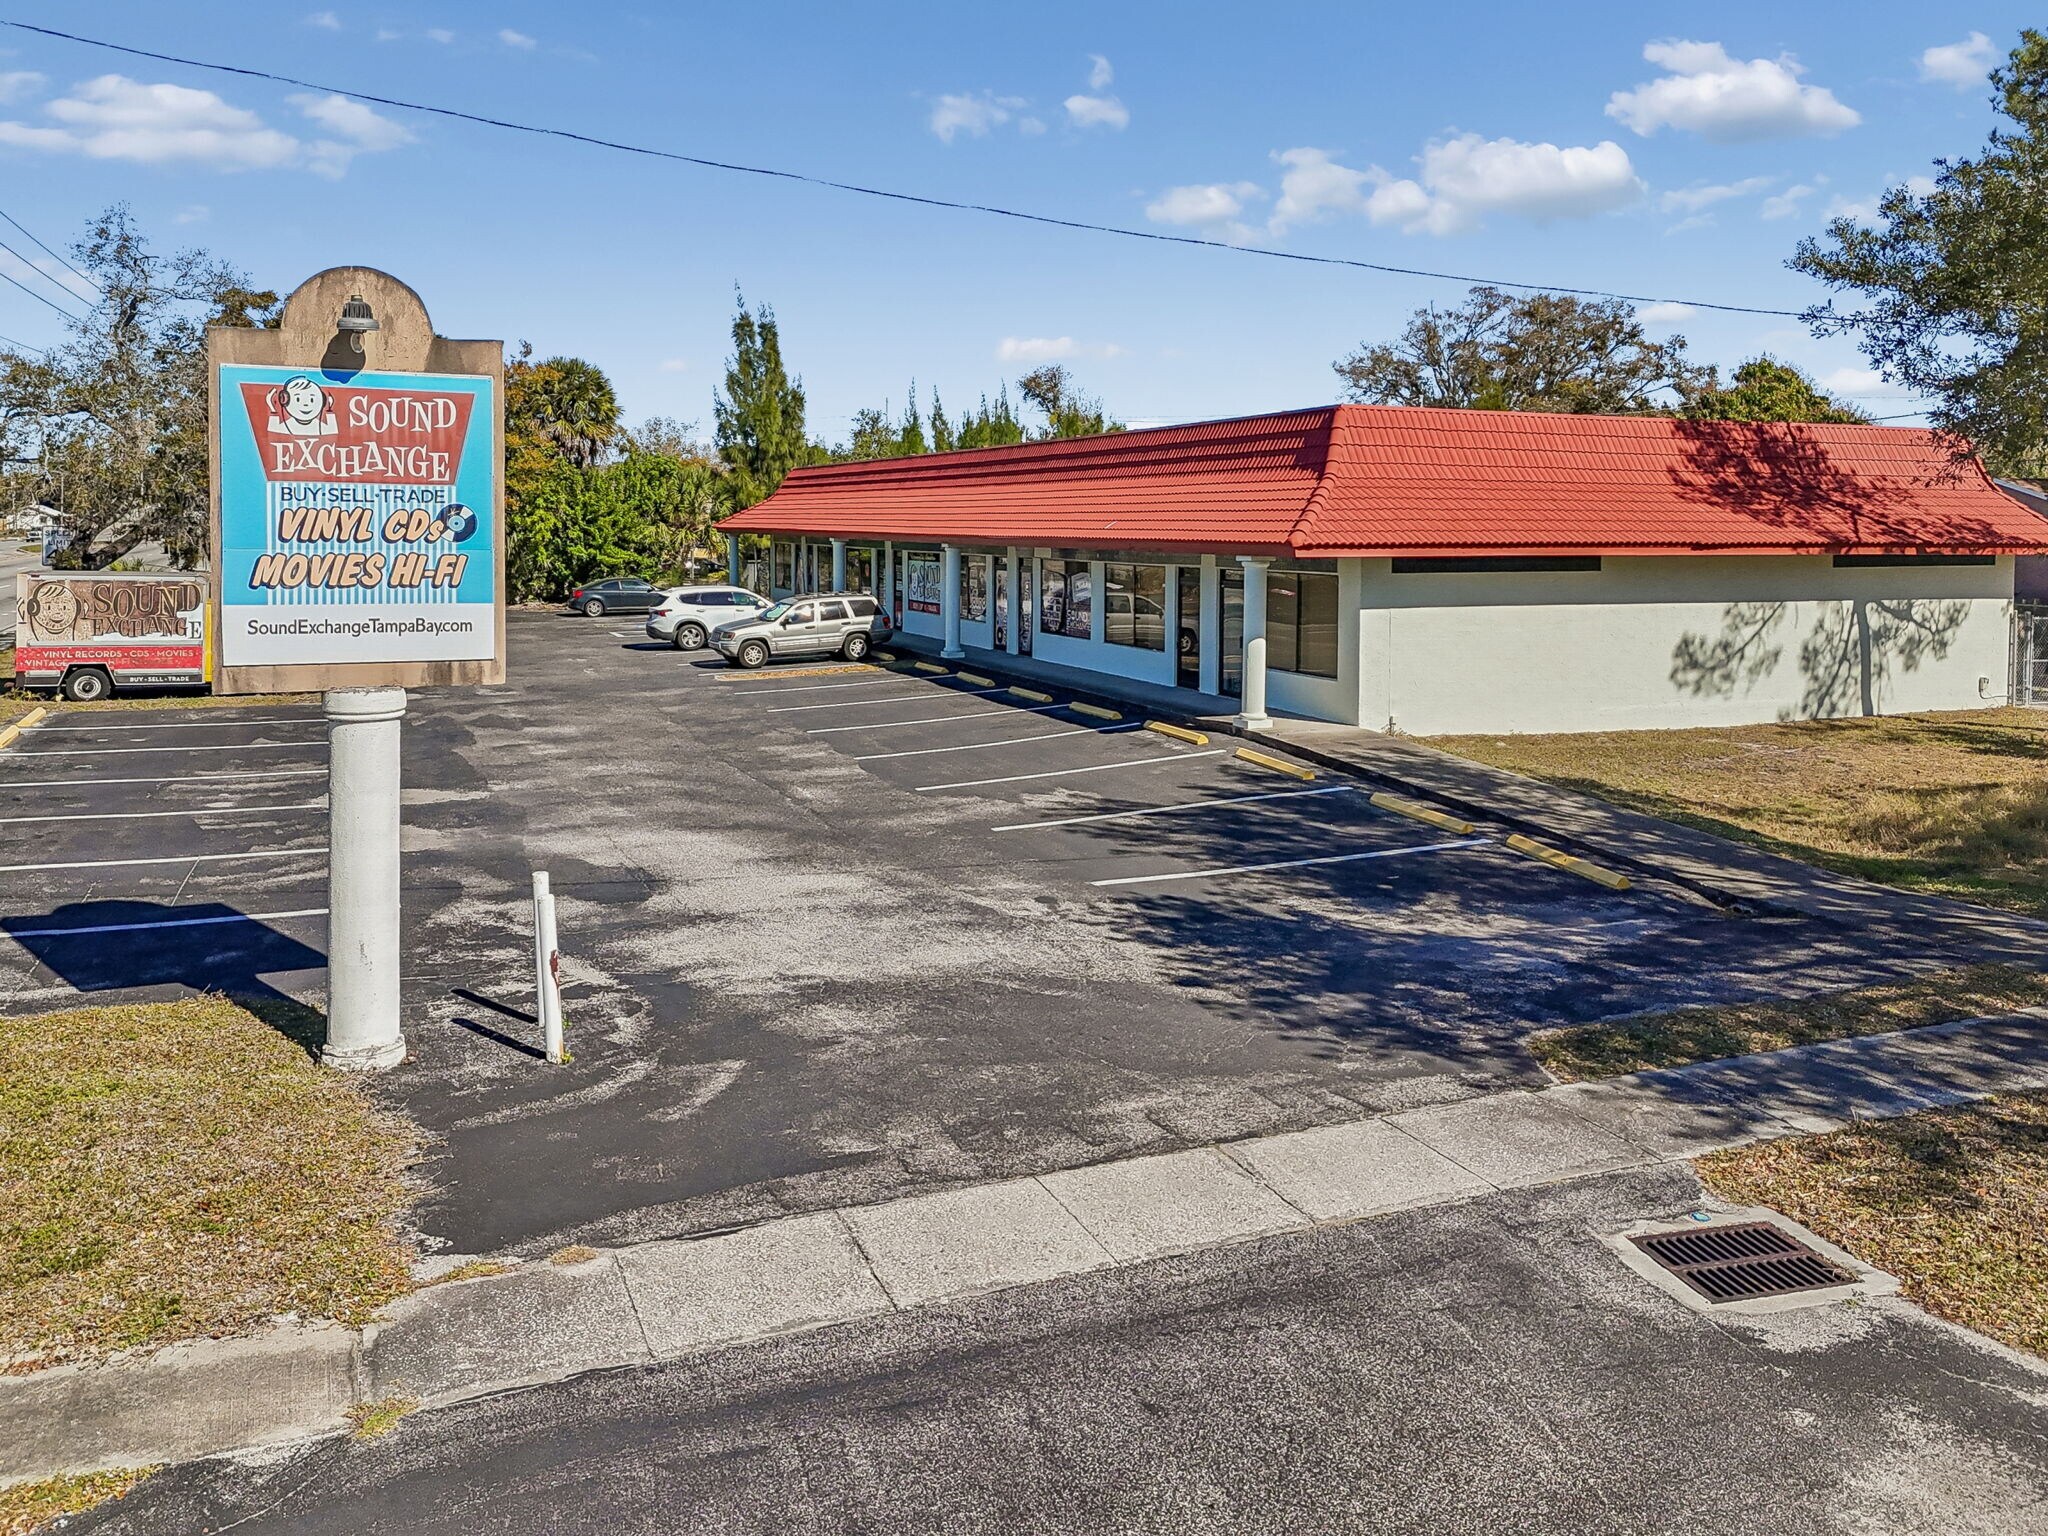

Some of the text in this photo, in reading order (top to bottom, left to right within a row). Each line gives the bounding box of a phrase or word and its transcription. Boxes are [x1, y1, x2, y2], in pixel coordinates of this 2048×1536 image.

[349, 395, 457, 434] SOUND
[270, 437, 450, 482] EXCHANGE
[277, 506, 445, 544] VINYL CDs
[248, 552, 469, 590] MOVIES HI-FI
[92, 582, 202, 619] SOUND
[1066, 609, 1088, 622] SOUND
[92, 615, 202, 640] EXCHANGE
[247, 617, 473, 638] SoundExchangeTampaBay.com
[25, 659, 67, 667] VINTAGE
[42, 650, 73, 659] VINYL
[75, 650, 122, 658] RECORDS
[156, 649, 194, 658] MOVIES
